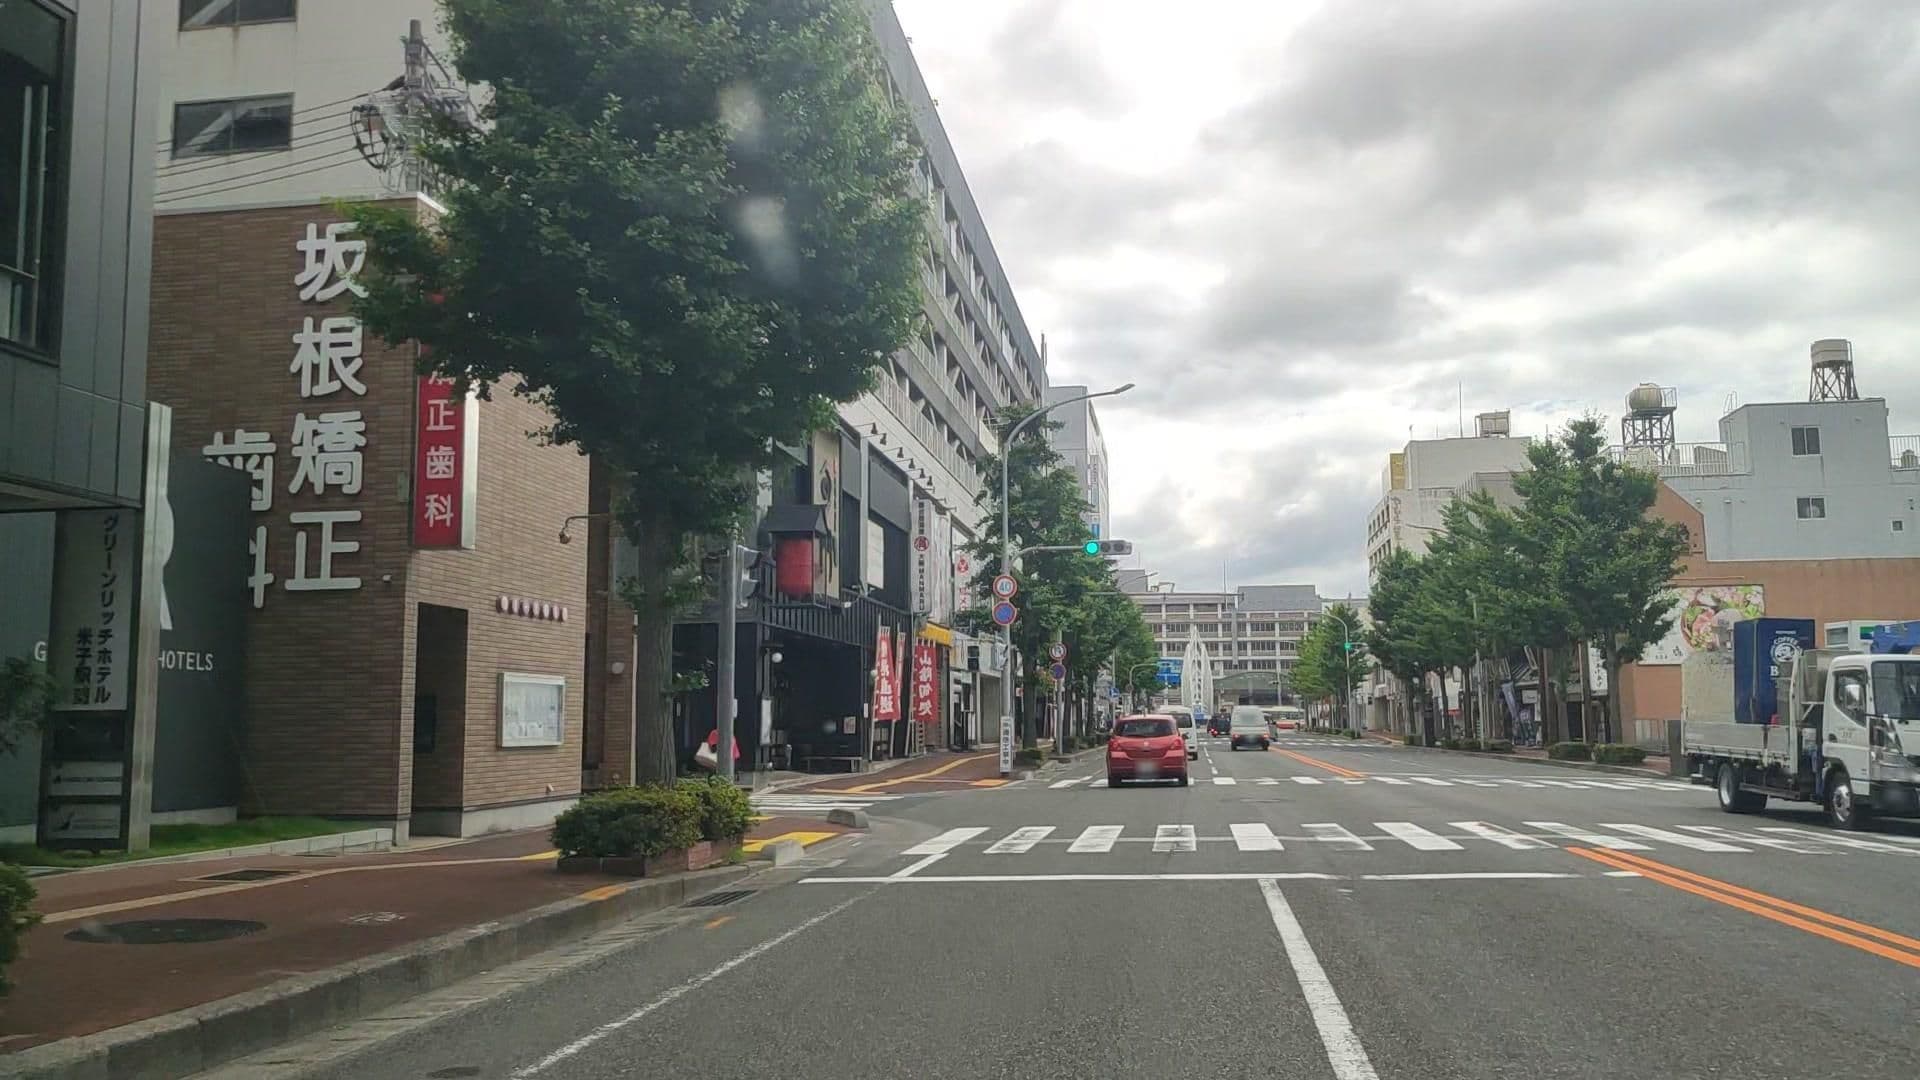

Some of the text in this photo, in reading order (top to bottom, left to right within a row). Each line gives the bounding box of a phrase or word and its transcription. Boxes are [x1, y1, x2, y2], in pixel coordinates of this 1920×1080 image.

[285, 221, 370, 591] 坂根矯正
[94, 513, 119, 704] グリーンリッチホテル
[999, 580, 1012, 593] 40
